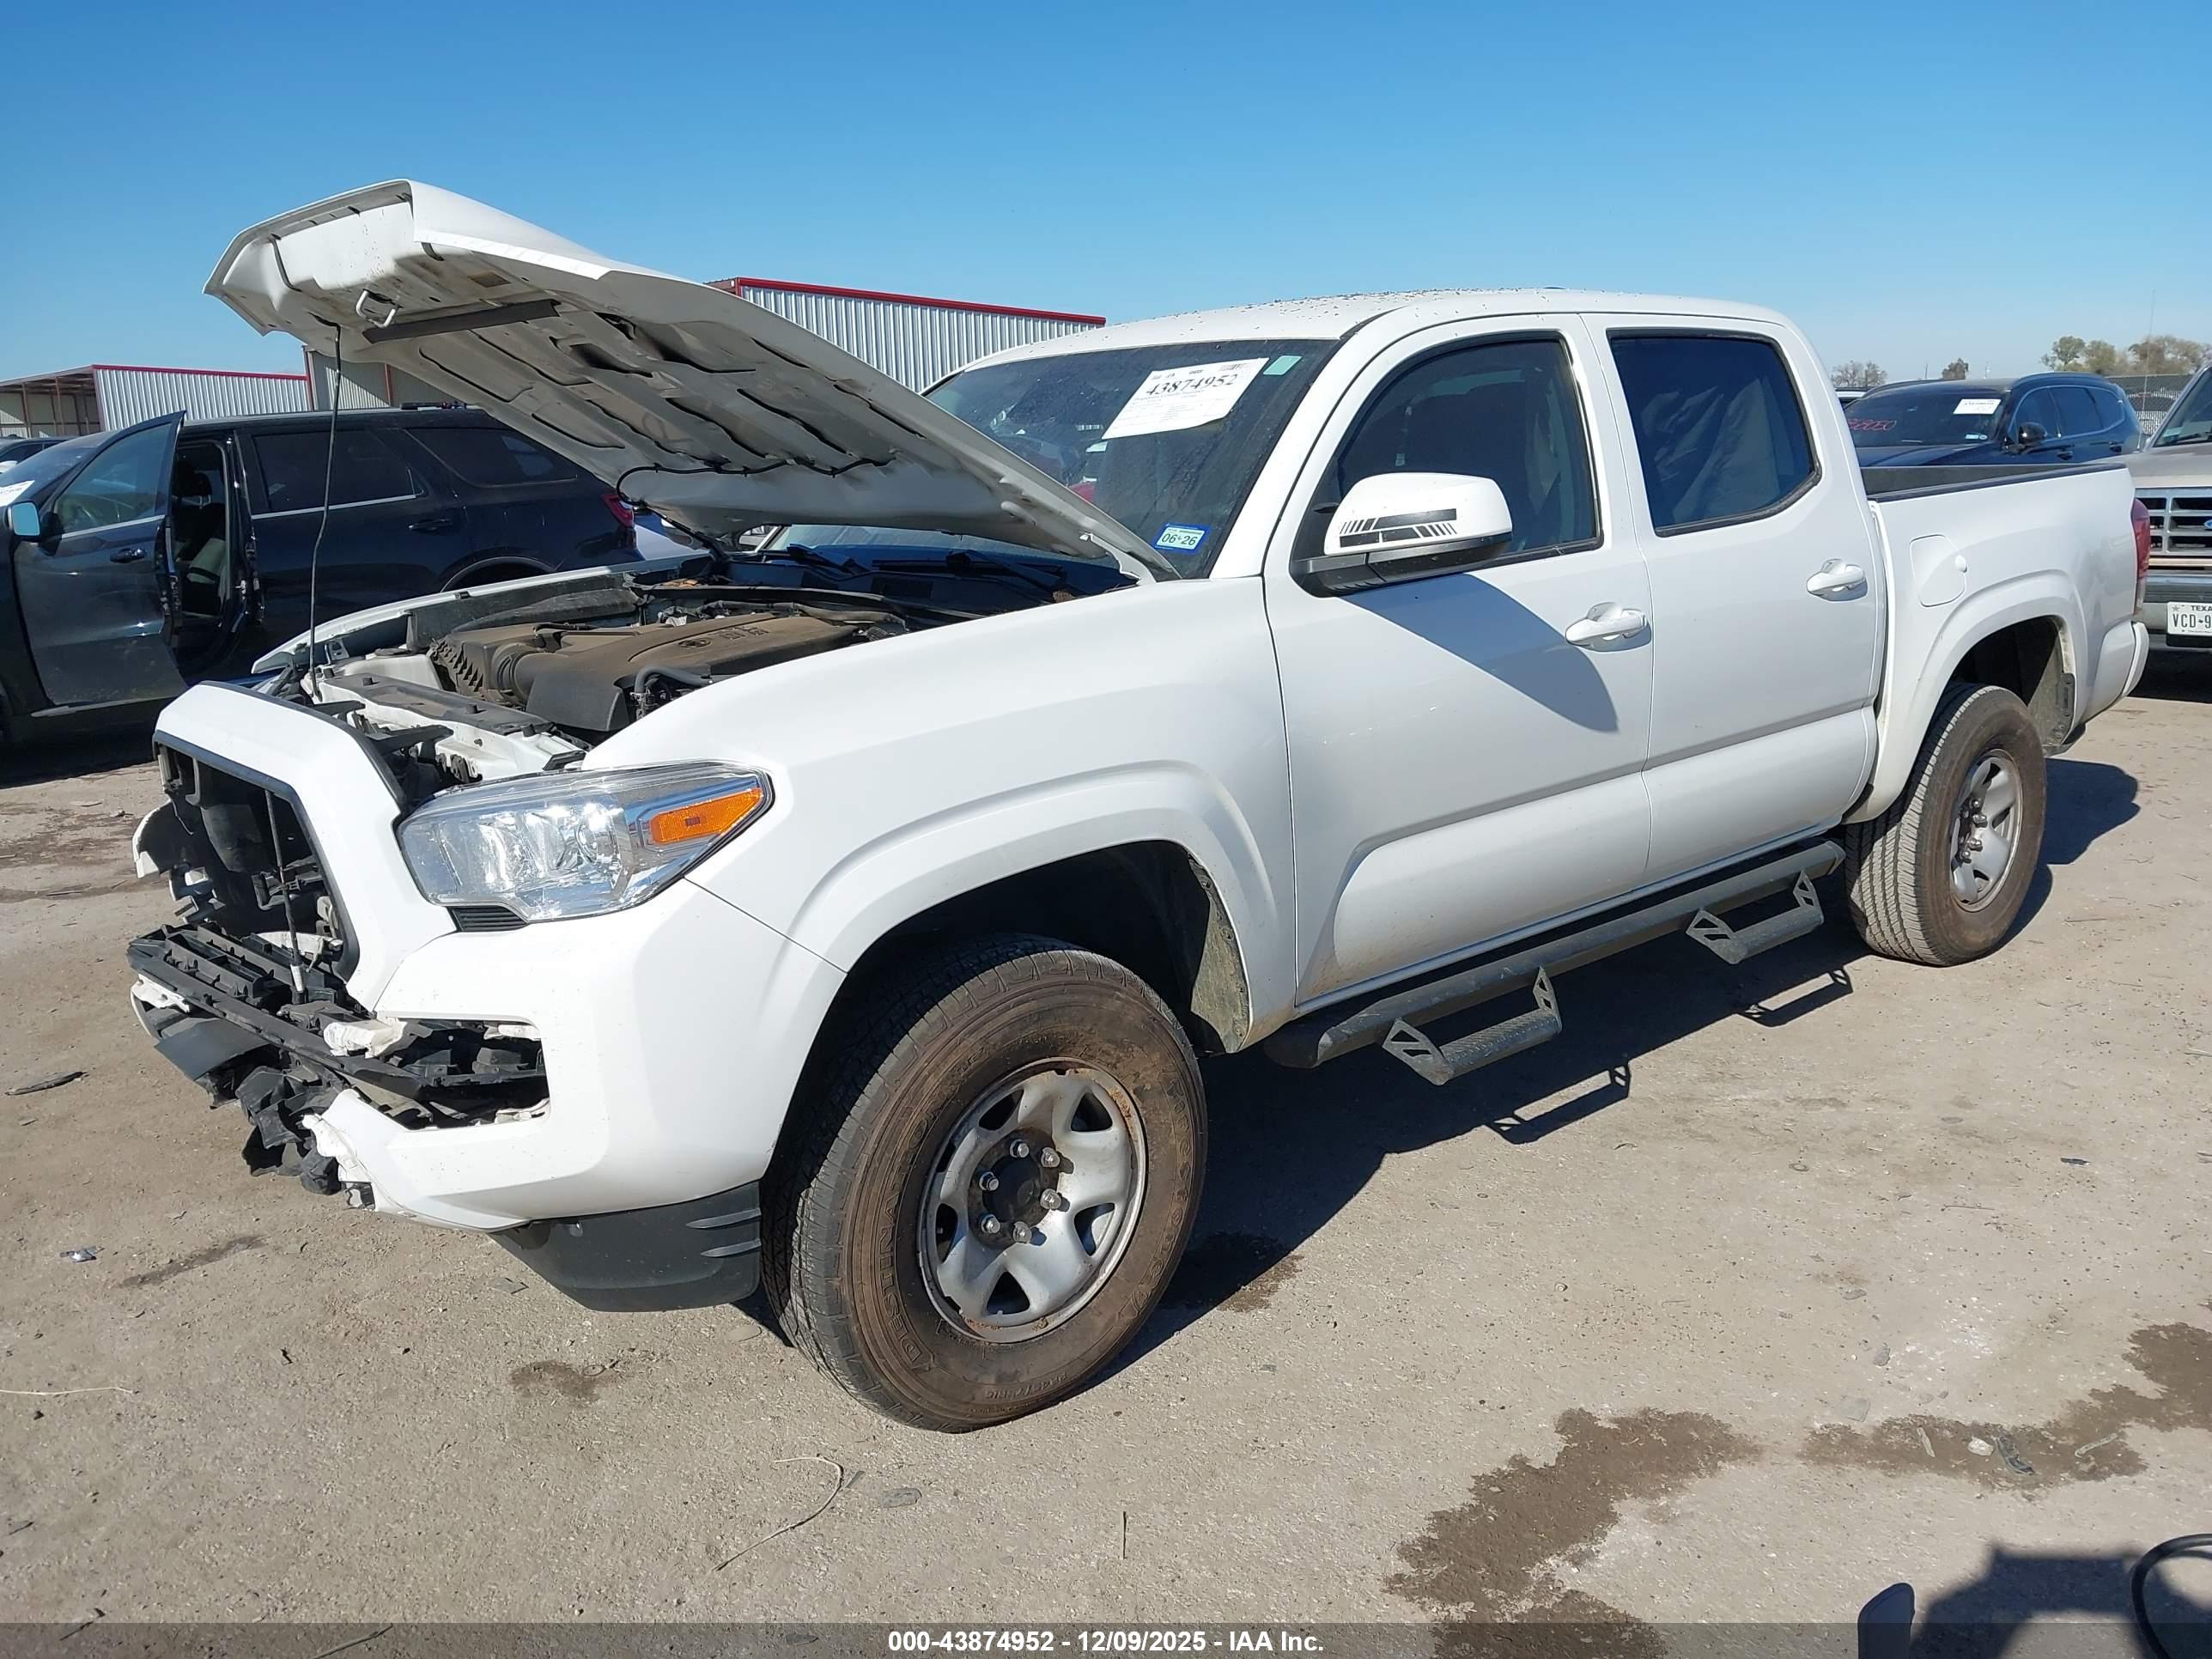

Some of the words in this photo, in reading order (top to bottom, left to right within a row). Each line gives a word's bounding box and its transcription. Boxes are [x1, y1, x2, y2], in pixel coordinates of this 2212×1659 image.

[1146, 374, 1238, 396] 43874952
[1161, 533, 1177, 543] 06
[1181, 536, 1198, 545] 26
